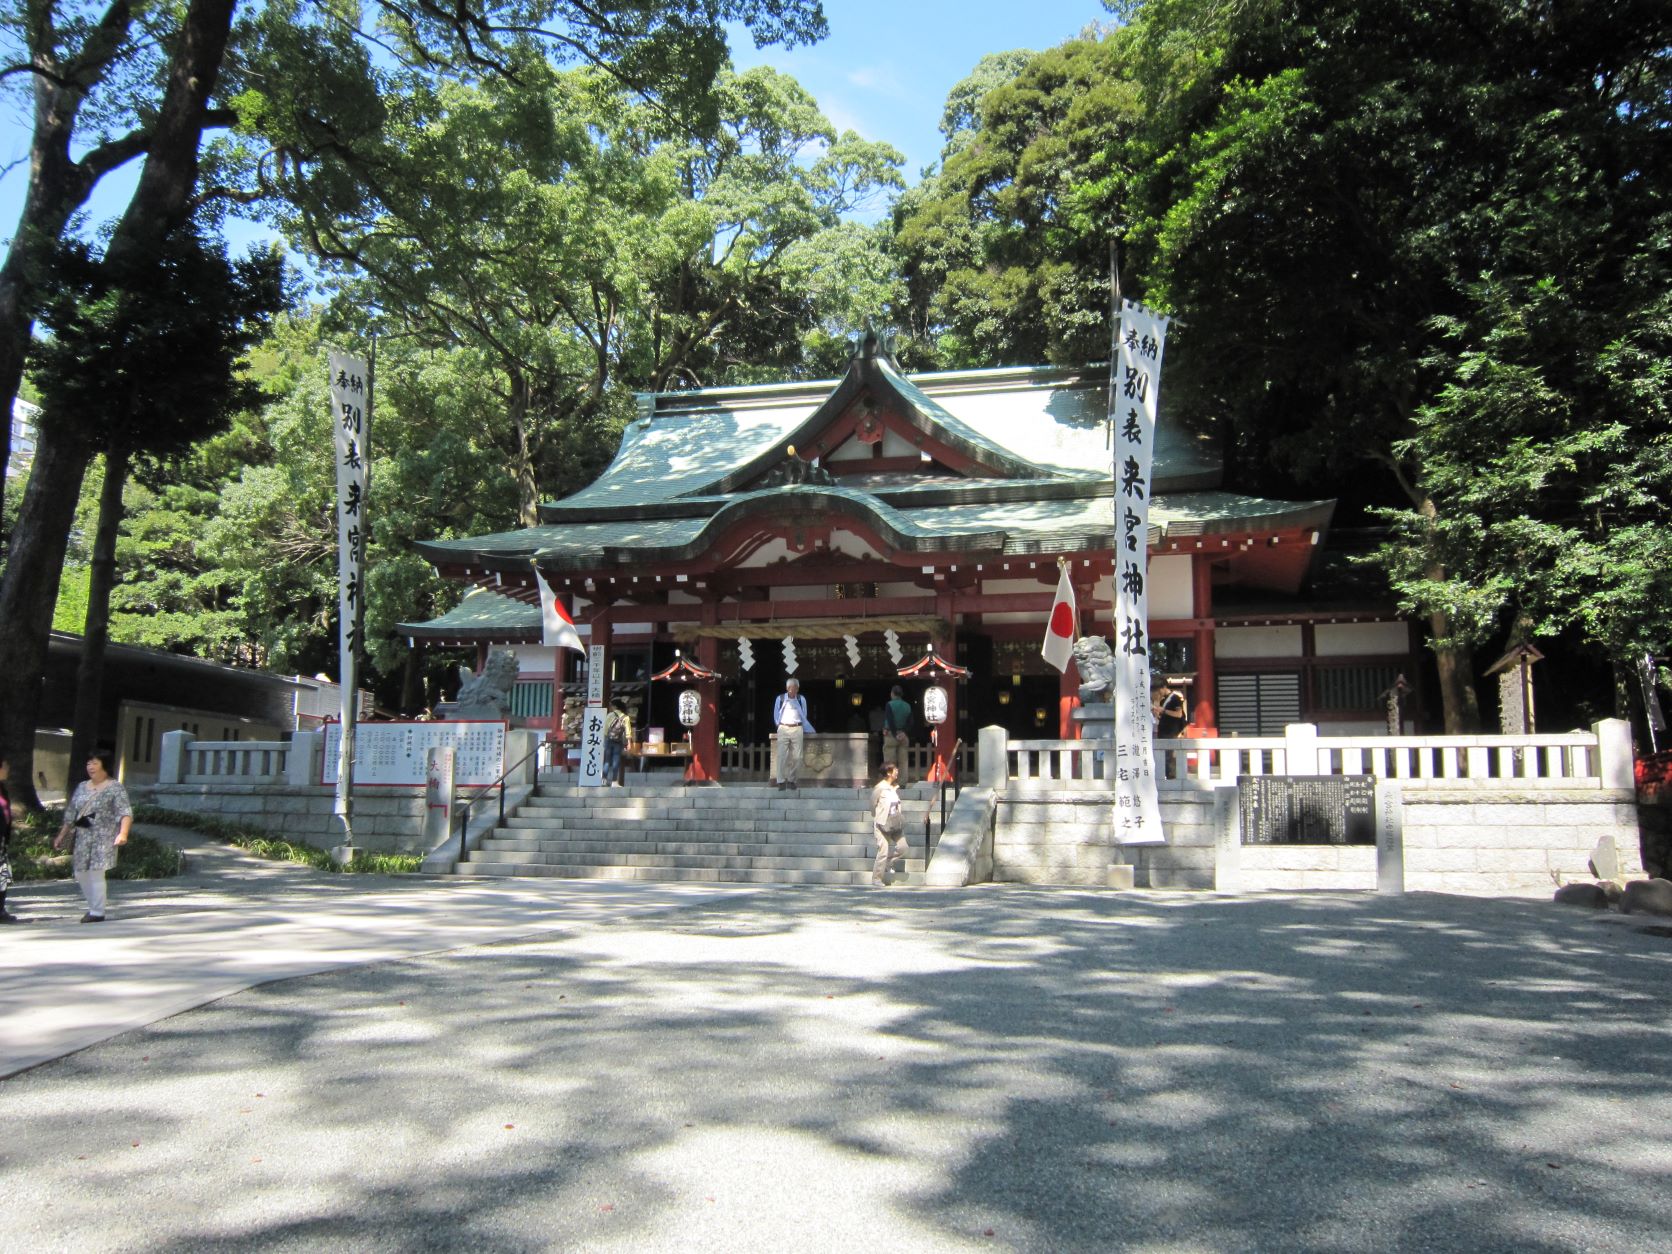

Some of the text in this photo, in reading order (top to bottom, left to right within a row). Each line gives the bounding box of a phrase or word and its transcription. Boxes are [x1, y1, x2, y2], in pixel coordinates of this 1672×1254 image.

[1123, 328, 1158, 361] 奉納
[335, 370, 363, 396] 奉納
[586, 715, 602, 777] おみくじ
